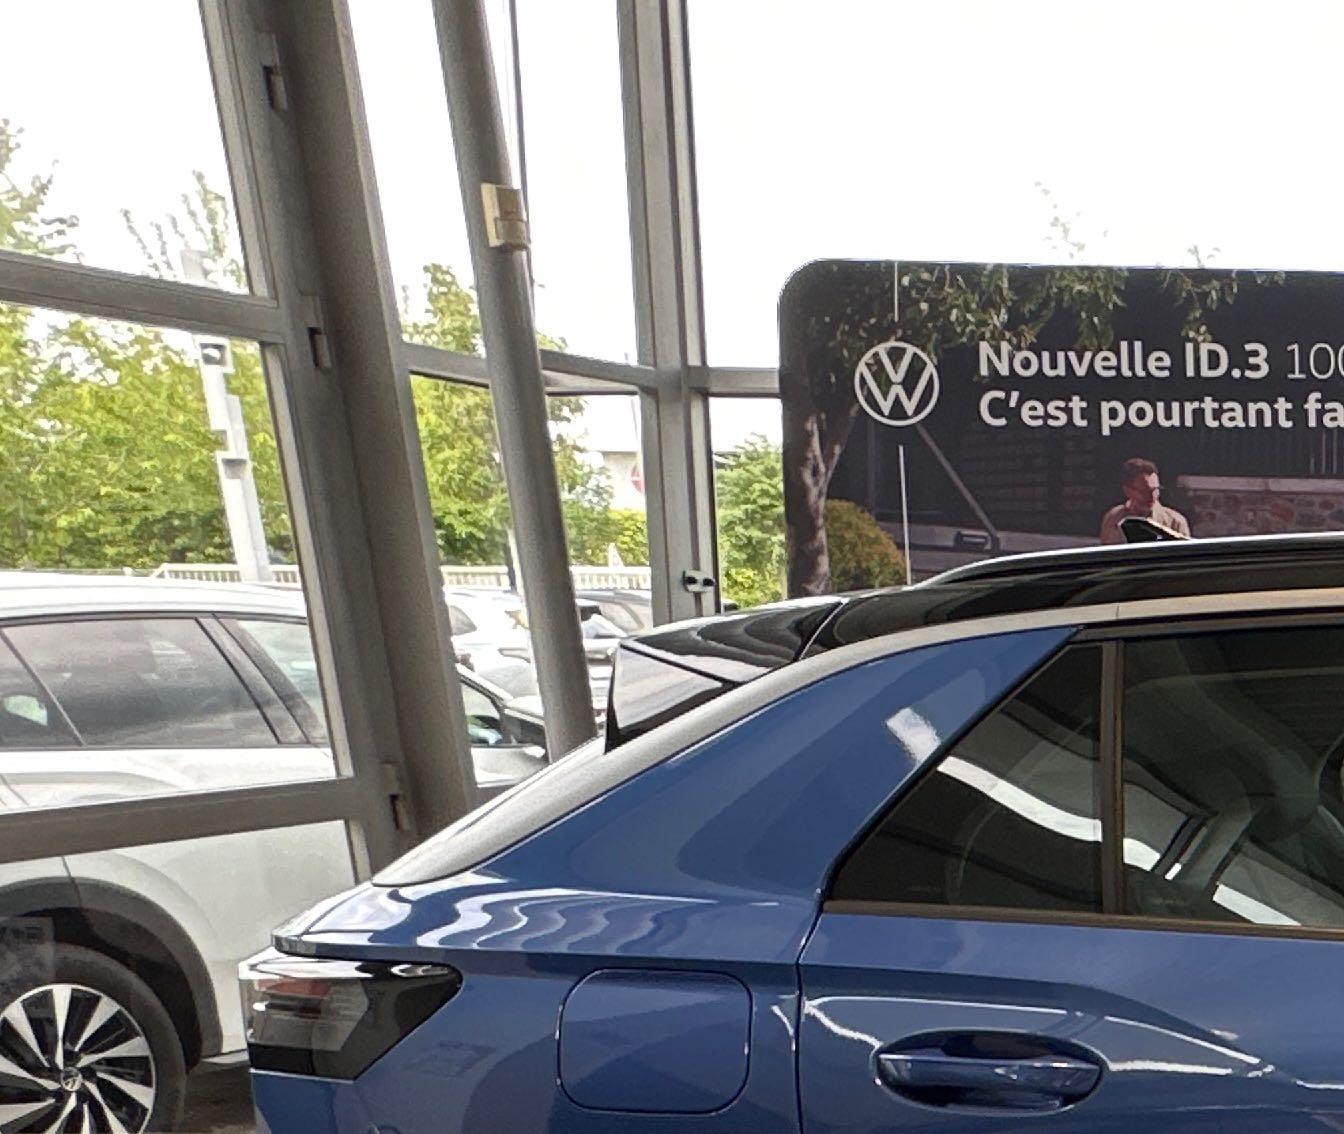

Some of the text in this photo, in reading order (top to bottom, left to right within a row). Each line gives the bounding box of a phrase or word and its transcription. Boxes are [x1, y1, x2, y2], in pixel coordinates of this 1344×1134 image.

[978, 340, 1173, 379] Nouvelle
[1185, 342, 1271, 379] ID.3
[979, 390, 1088, 428] C'est
[1100, 395, 1293, 436] pourtant
